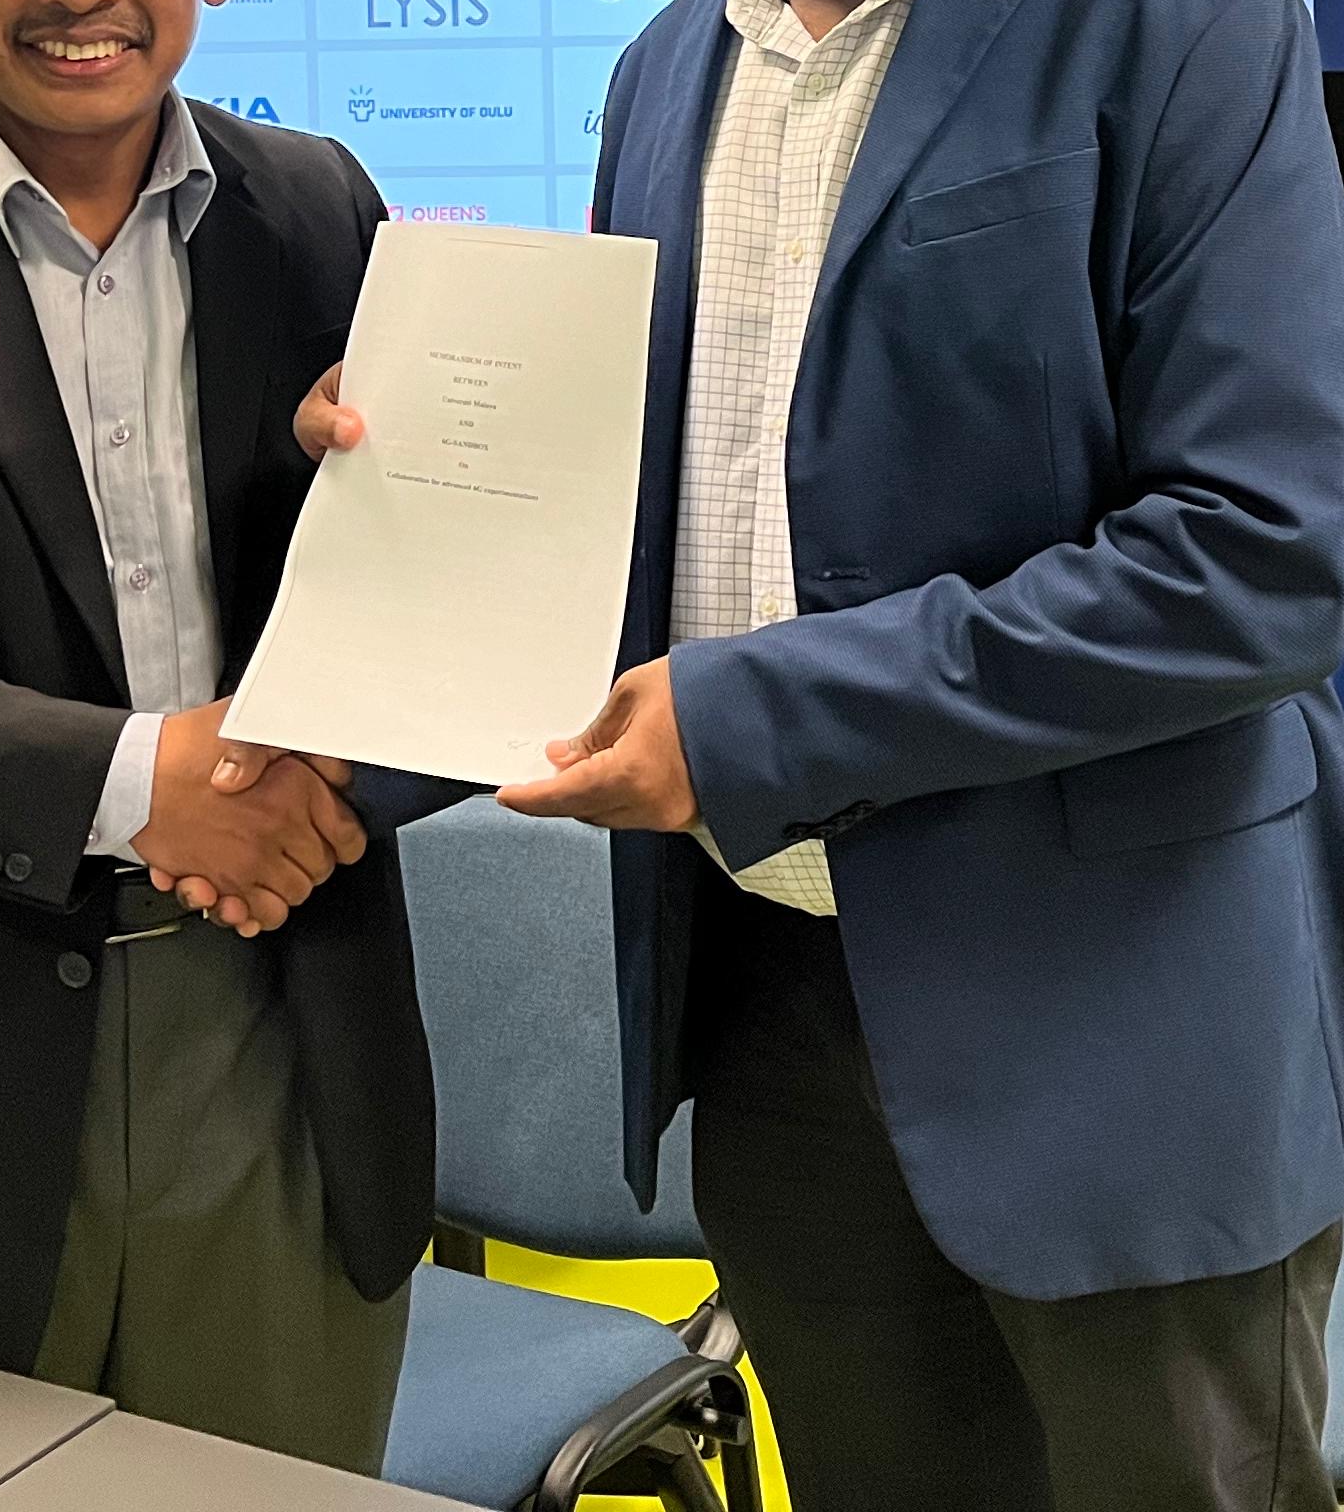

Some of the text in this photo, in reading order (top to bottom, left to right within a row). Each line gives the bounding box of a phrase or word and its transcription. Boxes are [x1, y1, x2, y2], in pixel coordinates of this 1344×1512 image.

[380, 106, 513, 119] UNIVERSITY OF OULU
[494, 360, 522, 370] INTENT
[453, 376, 488, 387] BETWEEN
